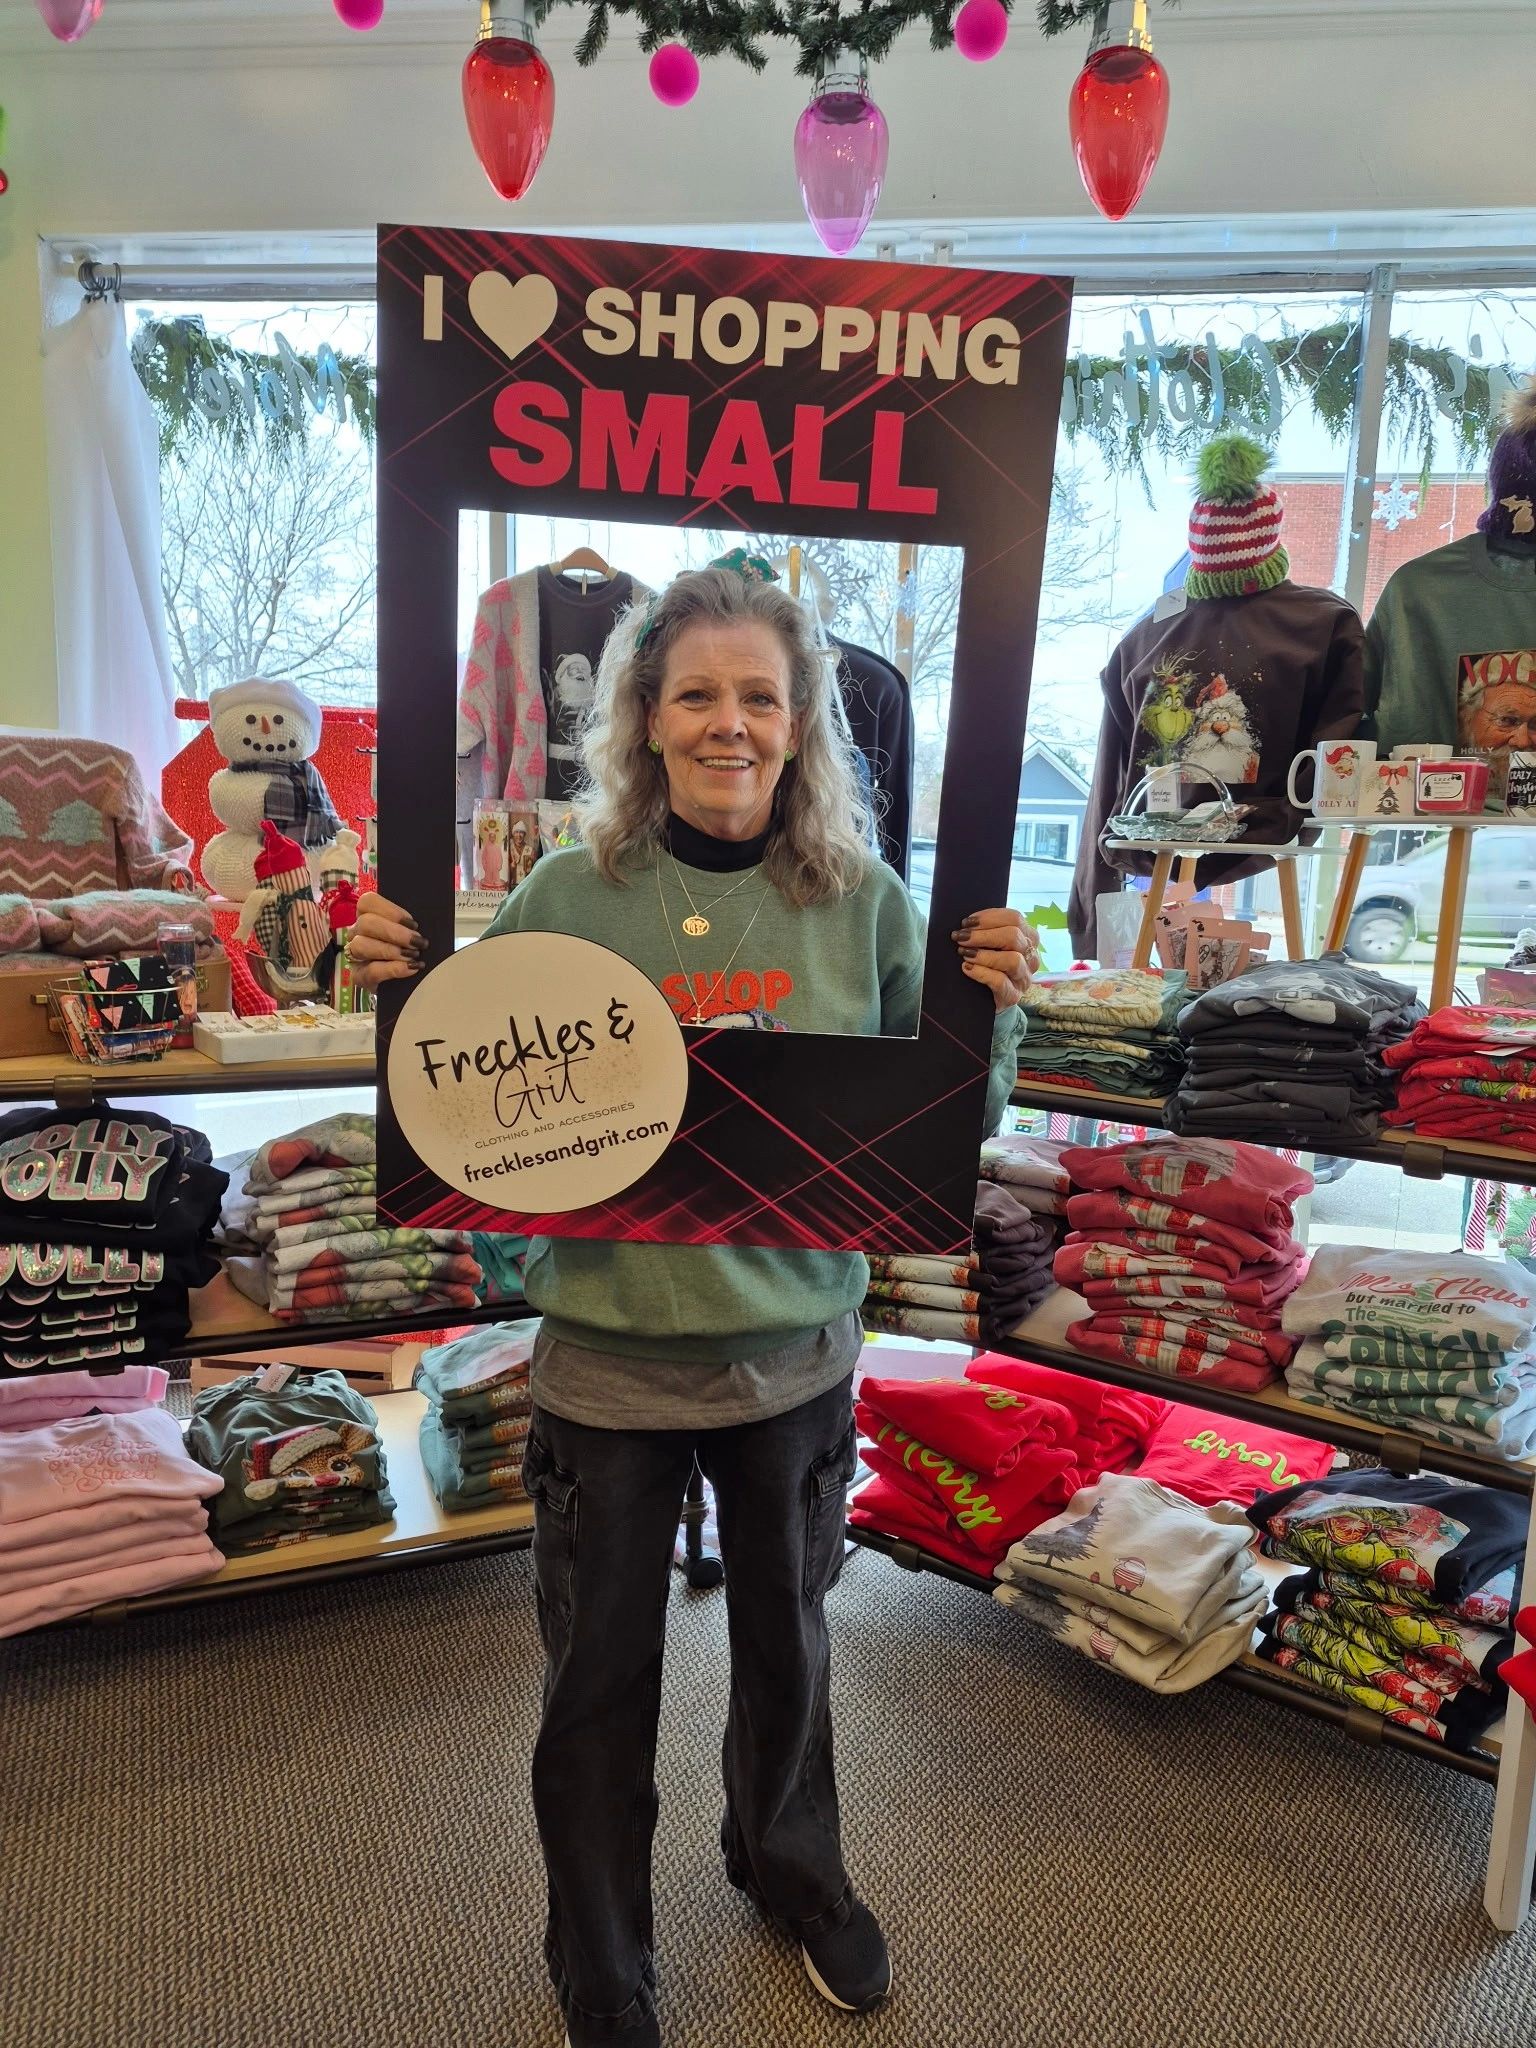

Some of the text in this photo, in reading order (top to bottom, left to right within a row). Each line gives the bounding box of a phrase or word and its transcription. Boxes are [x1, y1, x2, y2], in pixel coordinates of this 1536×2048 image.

[423, 274, 1021, 386] I SHOPPING
[489, 380, 938, 515] SMALL
[661, 968, 793, 1016] SHOP
[415, 997, 635, 1090] Freckles &
[494, 1053, 589, 1128] Grit
[475, 1102, 635, 1149] CLOTHING AND ACCESSORIES
[464, 1119, 669, 1183] frecklesandgrit.com
[0, 1149, 168, 1201] OLLY
[1345, 1292, 1476, 1315] but married to
[1345, 1307, 1377, 1322] The
[1427, 1277, 1530, 1309] Claus
[462, 1377, 498, 1394] HOLLY
[492, 1383, 527, 1400] HOLLY
[495, 1415, 527, 1427] JOLLY
